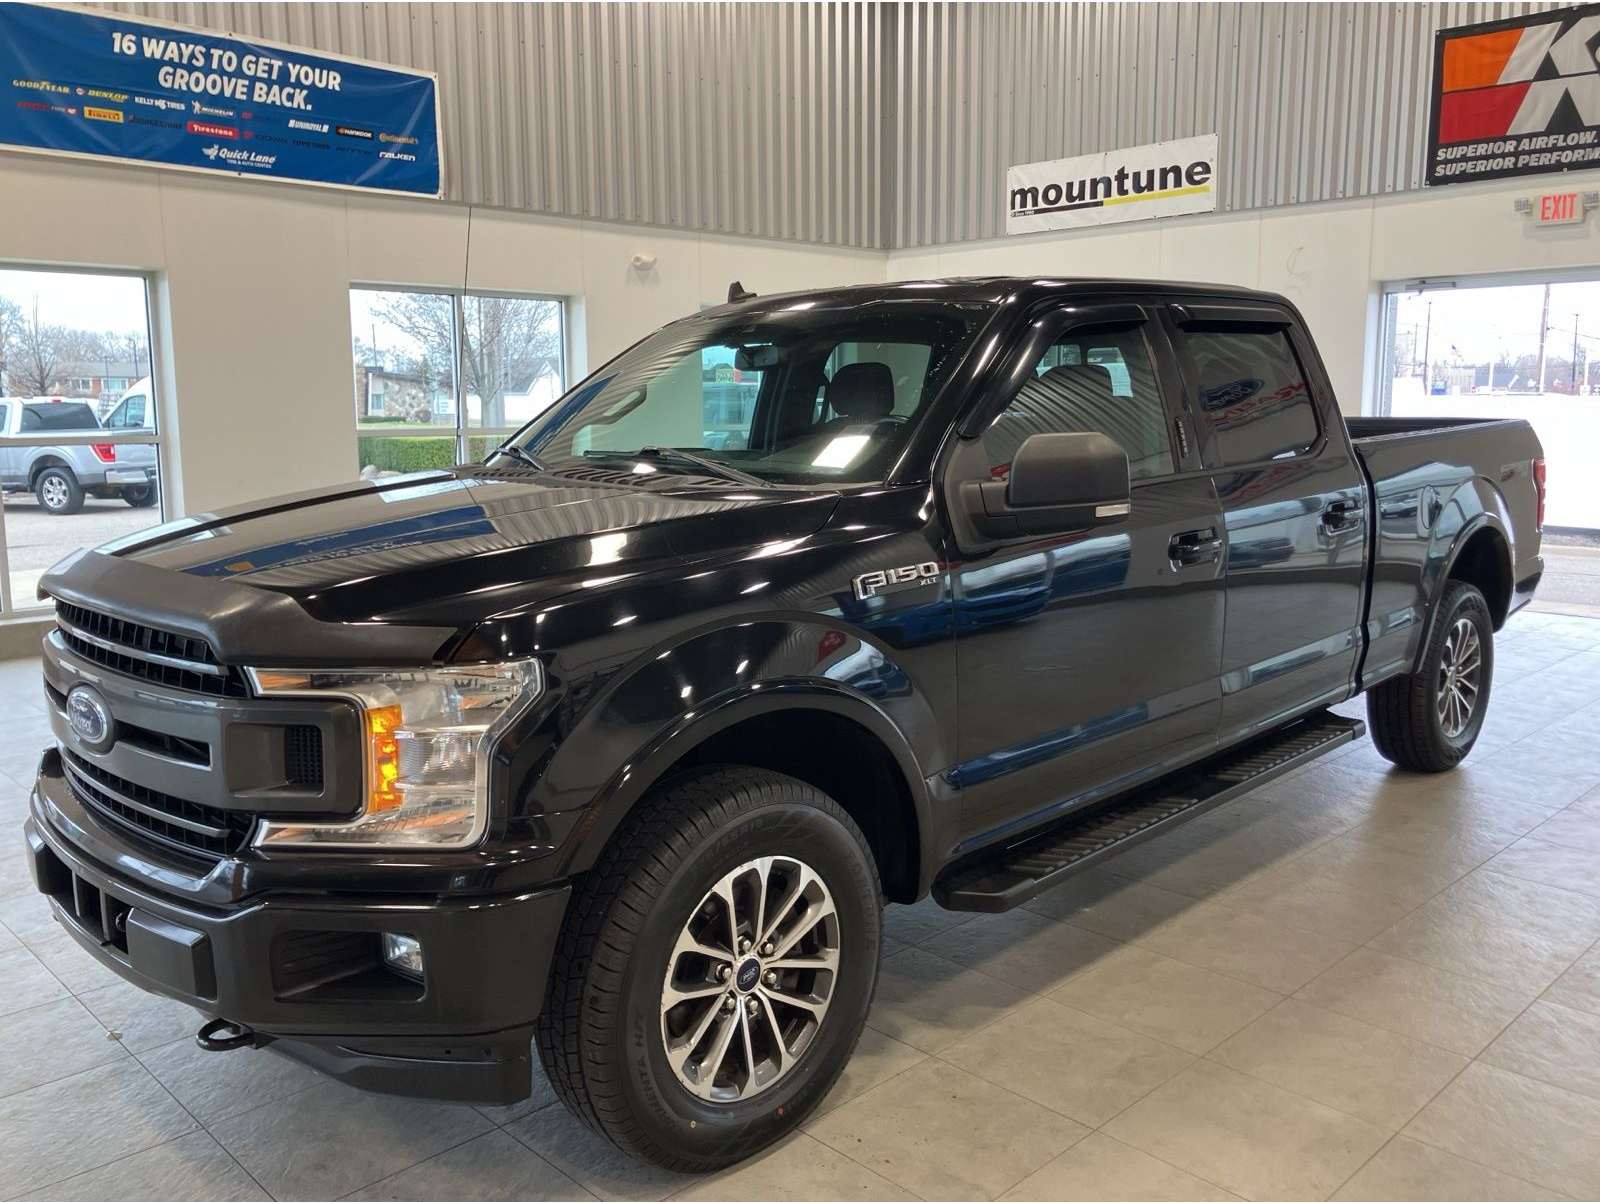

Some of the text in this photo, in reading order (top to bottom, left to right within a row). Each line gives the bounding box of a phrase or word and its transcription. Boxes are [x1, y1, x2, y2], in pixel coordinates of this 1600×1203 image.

[112, 32, 341, 91] 16 WAYS TO GET YOUR
[12, 79, 70, 94] GOODYEAR
[88, 89, 128, 102] DUNLOP
[158, 66, 312, 110] GROOVE BACK.
[219, 147, 276, 164] Quick Lane
[379, 151, 416, 162] FALKEN
[1436, 131, 1598, 161] SUPERIOR AIRFLOW.
[1434, 147, 1600, 177] SUPERIOR PERFORM
[1010, 160, 1212, 211] mountune
[1540, 193, 1577, 221] EXIT
[920, 576, 937, 586] XLT
